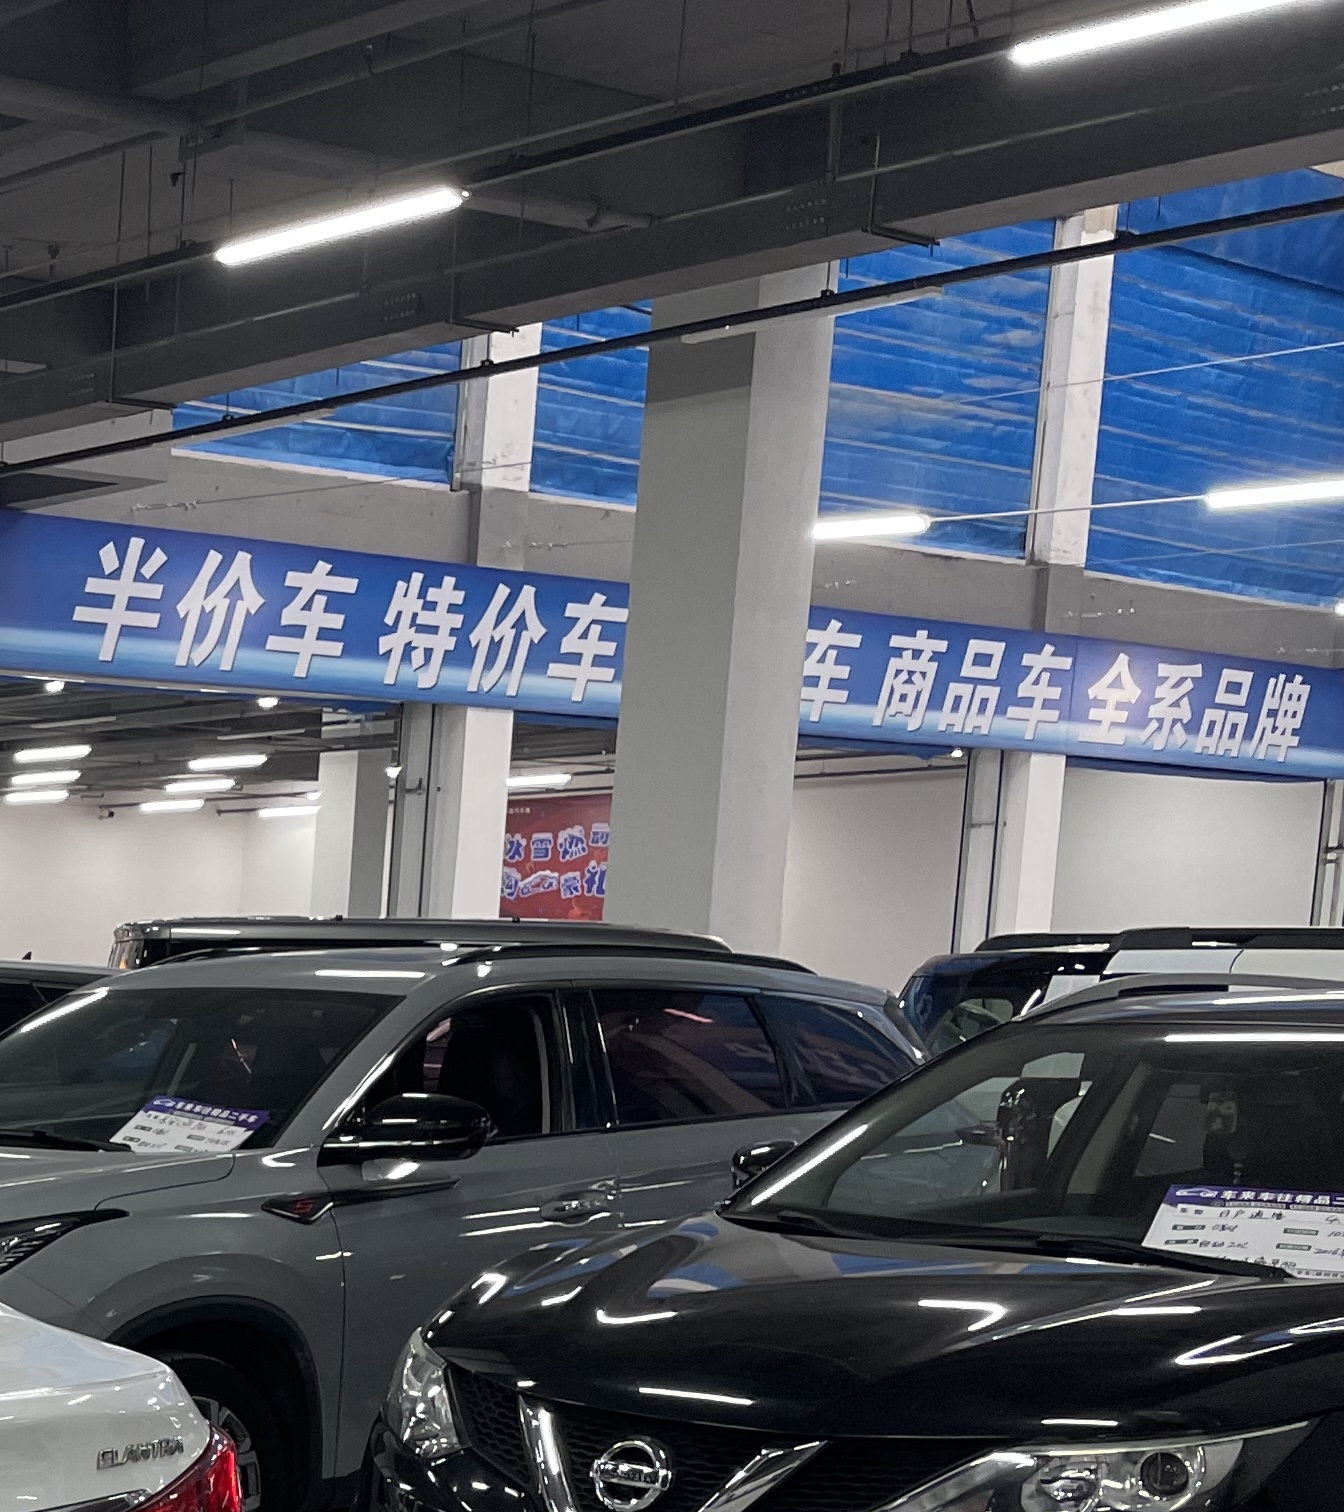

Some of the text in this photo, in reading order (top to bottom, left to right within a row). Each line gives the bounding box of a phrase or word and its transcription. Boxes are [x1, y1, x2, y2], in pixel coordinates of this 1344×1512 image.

[72, 536, 360, 678] 半价车
[378, 572, 630, 703] 特价车
